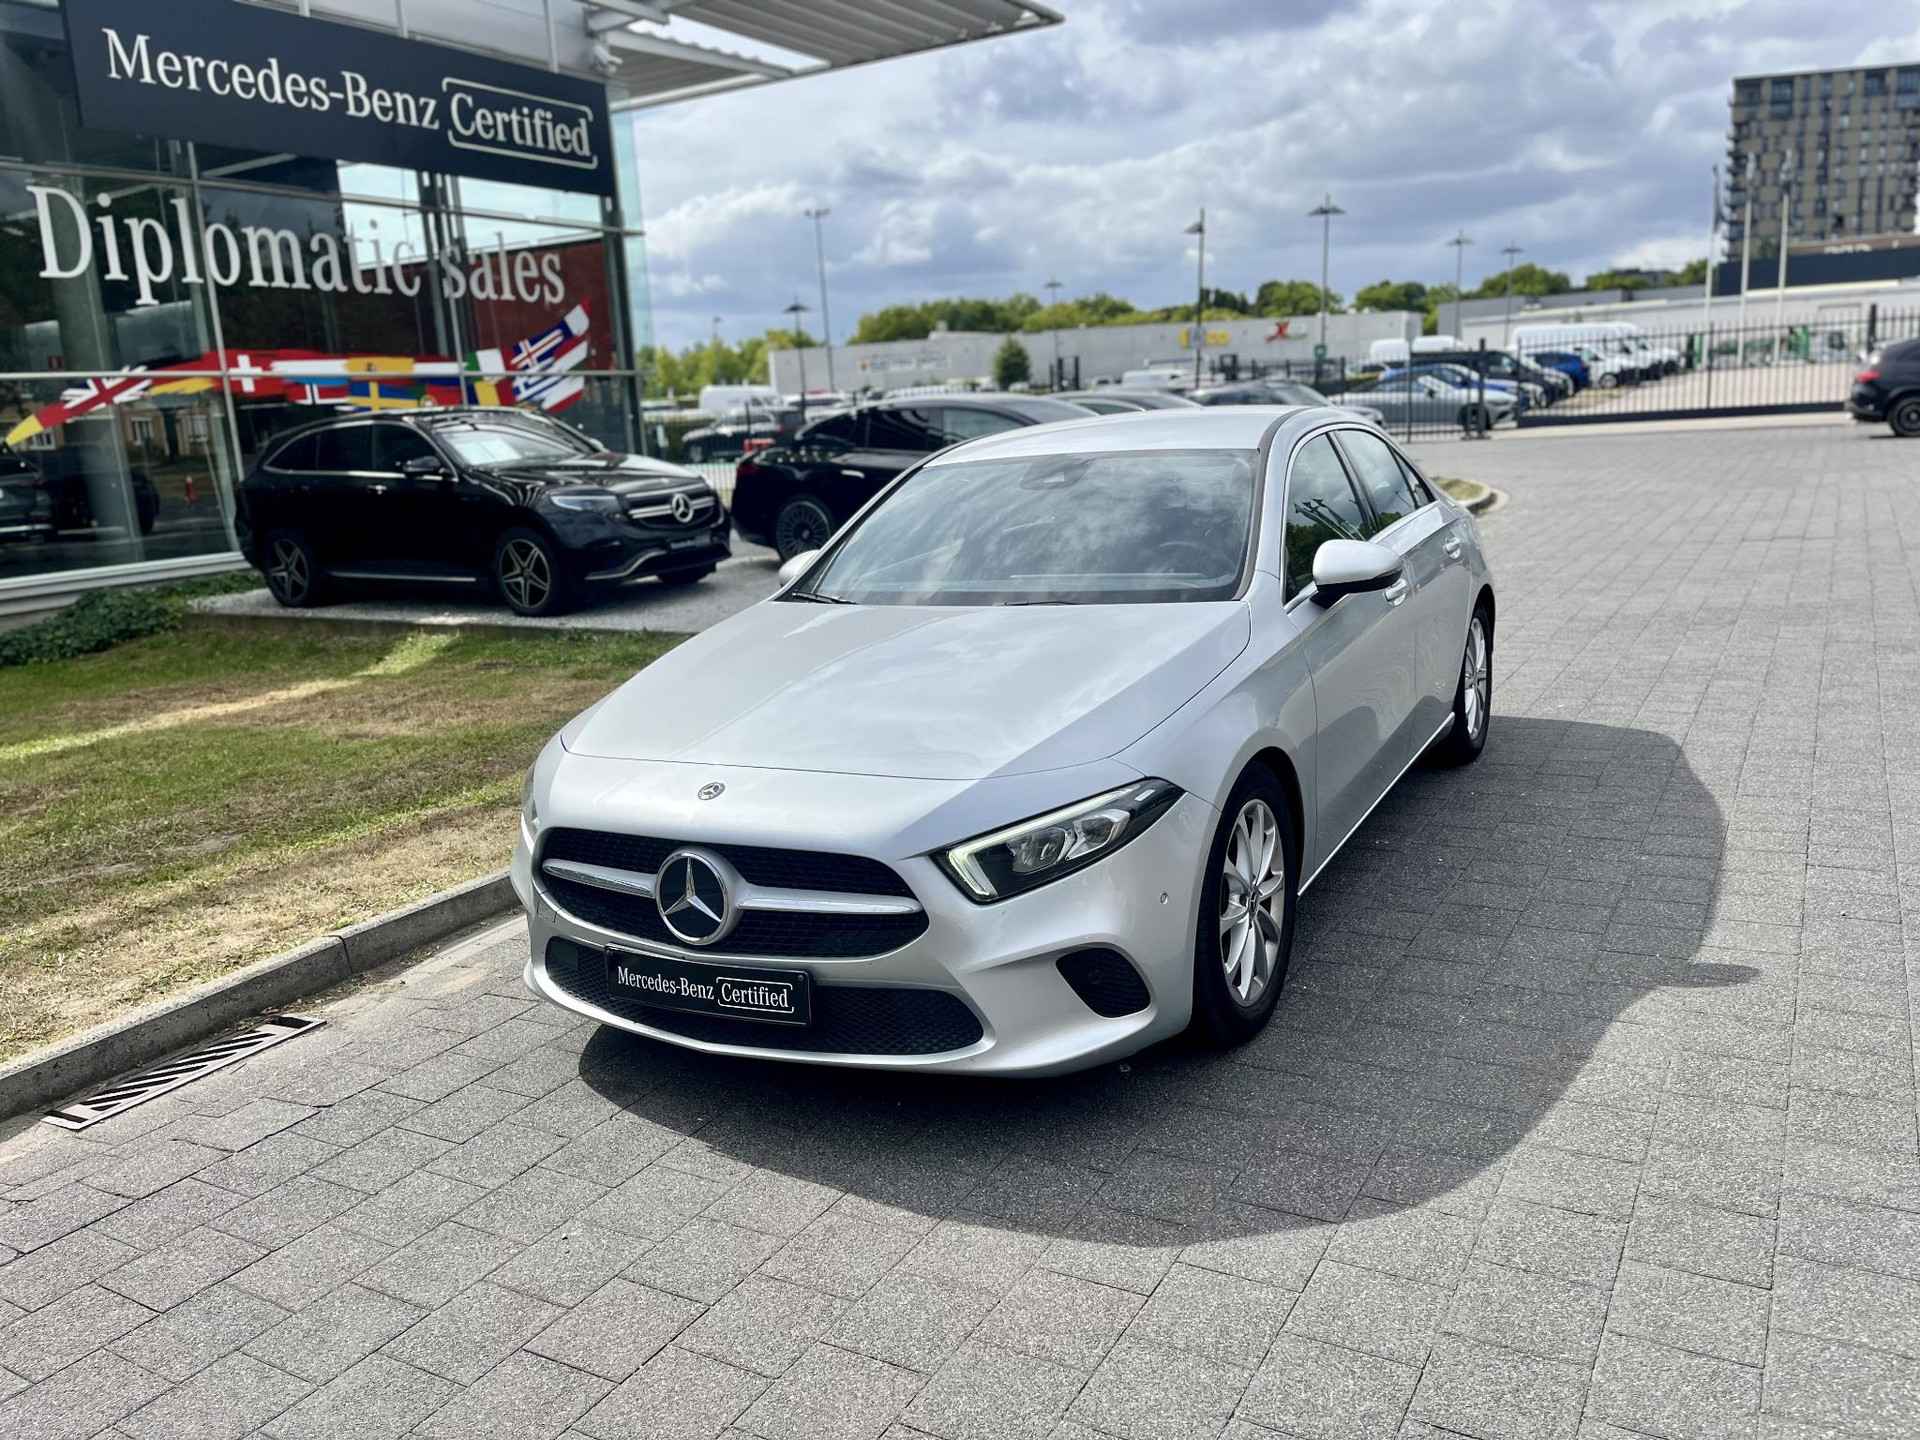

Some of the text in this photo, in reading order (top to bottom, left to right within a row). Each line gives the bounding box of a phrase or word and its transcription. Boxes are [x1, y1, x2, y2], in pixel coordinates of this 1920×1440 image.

[102, 28, 592, 157] Mercedes-Benz Certified
[26, 184, 567, 306] Diplomatic sales
[617, 966, 789, 1008] Mercedes-Benz Certified
